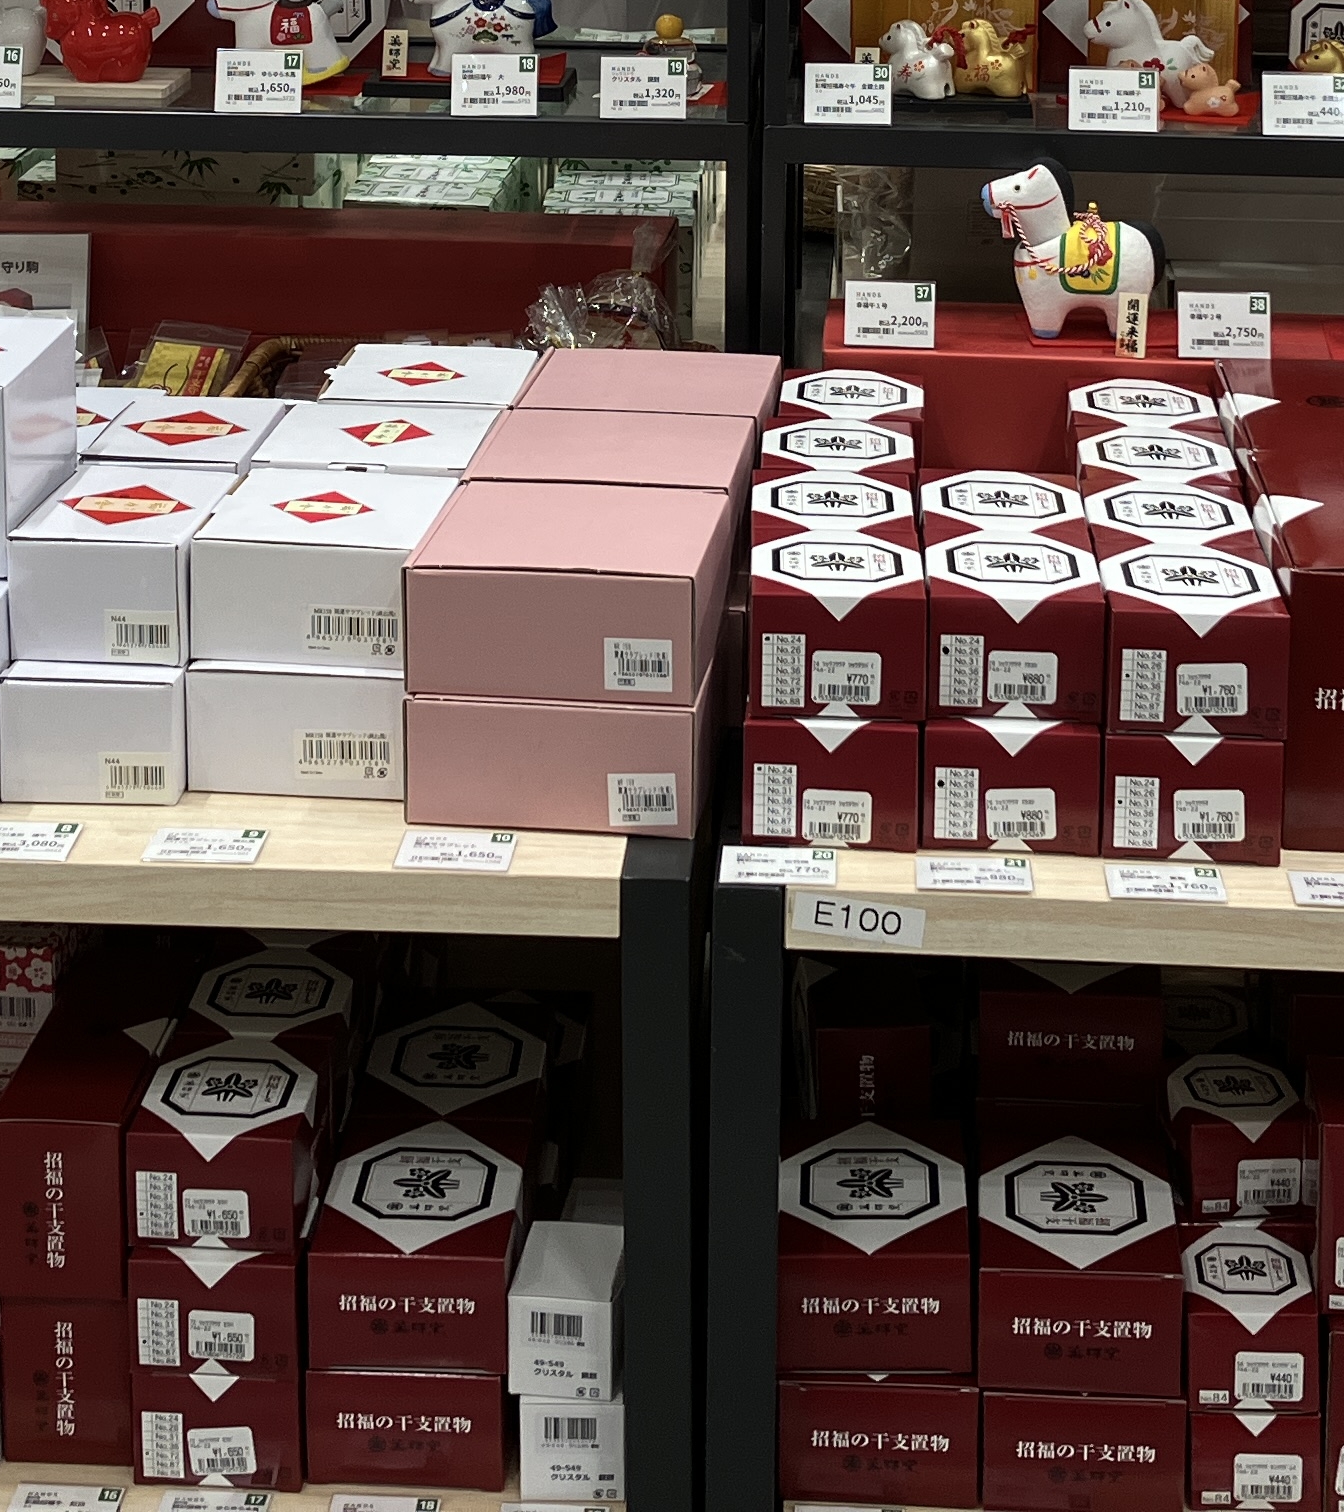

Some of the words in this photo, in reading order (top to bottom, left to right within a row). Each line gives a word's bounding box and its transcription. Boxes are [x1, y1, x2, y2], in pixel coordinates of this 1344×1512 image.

[280, 18, 300, 34] 福
[6, 50, 19, 61] 16
[670, 62, 682, 73] 19
[916, 286, 930, 299] 37
[1250, 298, 1264, 311] 38
[776, 636, 802, 644] No.24
[847, 674, 868, 684] ¥770
[813, 903, 903, 939] E100
[44, 1151, 67, 1269] 招福の干支置物
